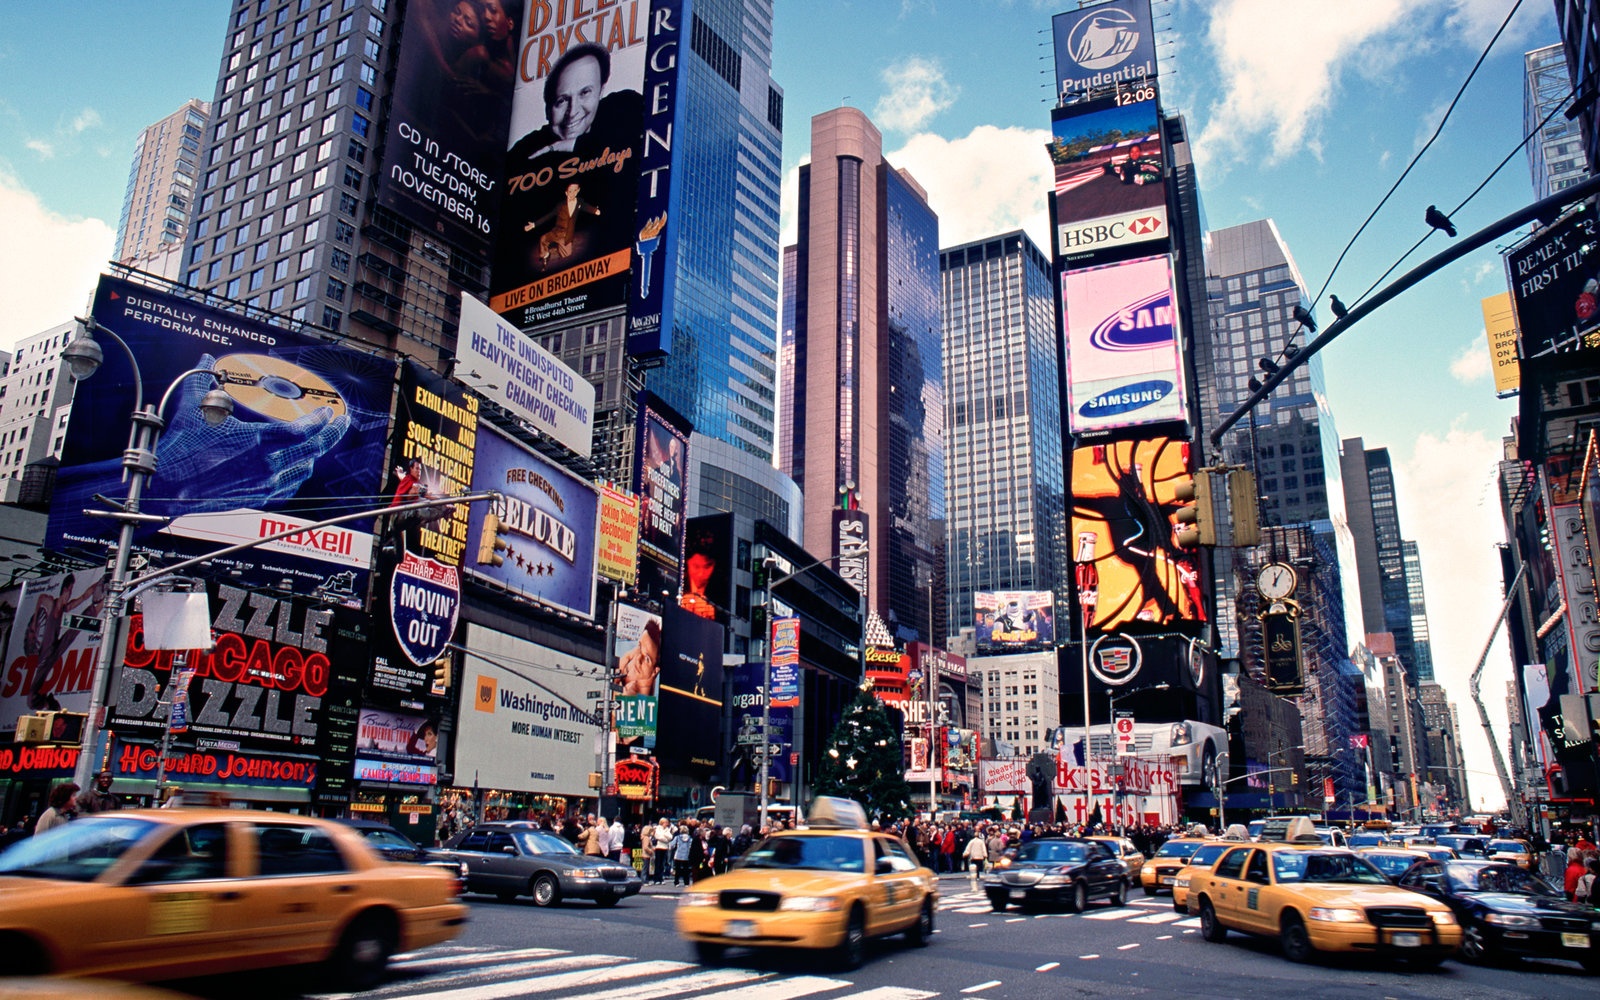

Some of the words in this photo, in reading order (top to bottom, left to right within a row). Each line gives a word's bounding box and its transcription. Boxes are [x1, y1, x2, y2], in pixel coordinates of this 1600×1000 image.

[521, 1, 644, 83] CRYSTAL
[1062, 61, 1152, 93] Prudential
[1114, 87, 1155, 107] 12:06
[399, 123, 421, 144] CD
[426, 138, 439, 158] IN
[442, 153, 495, 191] STORES
[414, 152, 477, 205] TUESDAY,
[508, 167, 553, 195] 700
[558, 147, 632, 180] Sundays
[392, 165, 474, 224] NOVEMBER
[478, 214, 490, 233] 16
[1064, 222, 1126, 248] HSBC
[1517, 219, 1597, 277] REMEMR
[504, 289, 526, 309] LIVE
[529, 282, 544, 301] ON
[547, 258, 612, 294] BROADWAY
[1521, 262, 1560, 298] FIRST
[536, 311, 551, 321] West
[551, 307, 565, 317] 44th
[566, 302, 585, 314] Street
[564, 294, 588, 306] Theatre
[124, 308, 233, 346] PERFORMANCE.
[126, 296, 196, 323] DIGITALLY
[203, 318, 276, 346] ENHANCED
[1118, 305, 1172, 331] SAM
[496, 323, 515, 352] THE
[518, 340, 574, 393] UNDISPUTED
[1497, 349, 1510, 358] ON
[471, 331, 545, 395] HEAVYWEIGHT
[546, 382, 587, 425] CHECKING
[415, 385, 477, 432] EXHILARATING
[505, 380, 557, 428] CHAMPION.
[1089, 389, 1162, 409] SAMSUNG
[407, 420, 474, 468] SOUL-STIRRING
[457, 426, 475, 449] AND
[403, 439, 415, 459] IT
[416, 444, 473, 486] PRACTICALLY
[506, 469, 527, 485] FREE
[528, 471, 565, 513] CHECKING
[647, 469, 680, 499] FOREFATHERS
[649, 497, 664, 517] COME
[664, 506, 677, 524] HERE
[652, 513, 659, 528] TO
[259, 518, 353, 555] maxell
[440, 517, 451, 534] OF
[452, 520, 468, 542] THE
[63, 532, 97, 544] Recordable
[142, 546, 163, 555] Storage
[211, 558, 235, 566] Portable
[261, 564, 294, 575] Technological
[295, 569, 324, 581] Partnerships
[276, 541, 305, 552] Expanding
[306, 547, 328, 556] Memory
[130, 559, 144, 567] WAY
[409, 561, 434, 579] THARP
[442, 571, 458, 588] JOEL
[400, 582, 455, 618] MOVIN'
[75, 617, 84, 629] 7
[89, 619, 98, 627] AV
[408, 619, 440, 648] OUT
[375, 656, 388, 666] CALL
[865, 647, 901, 663] Reese's
[2, 647, 99, 699] STOM
[261, 671, 286, 681] MUSICAL
[500, 689, 567, 722] Washington
[616, 699, 655, 722] RENT
[300, 737, 316, 745] Sprint
[361, 725, 393, 742] WONDERFUL
[512, 721, 530, 735] MORE
[531, 724, 552, 739] HUMAN
[553, 728, 582, 744] INTEREST
[119, 744, 217, 776] HOWARD
[217, 754, 316, 784] JOHNSON'S
[361, 767, 393, 780] CAMERAS
[530, 771, 555, 781] wamu.com
[616, 766, 649, 783] ROXY
[988, 763, 1013, 777] theatre
[985, 768, 1026, 787] developme
[1009, 777, 1027, 787] fund
